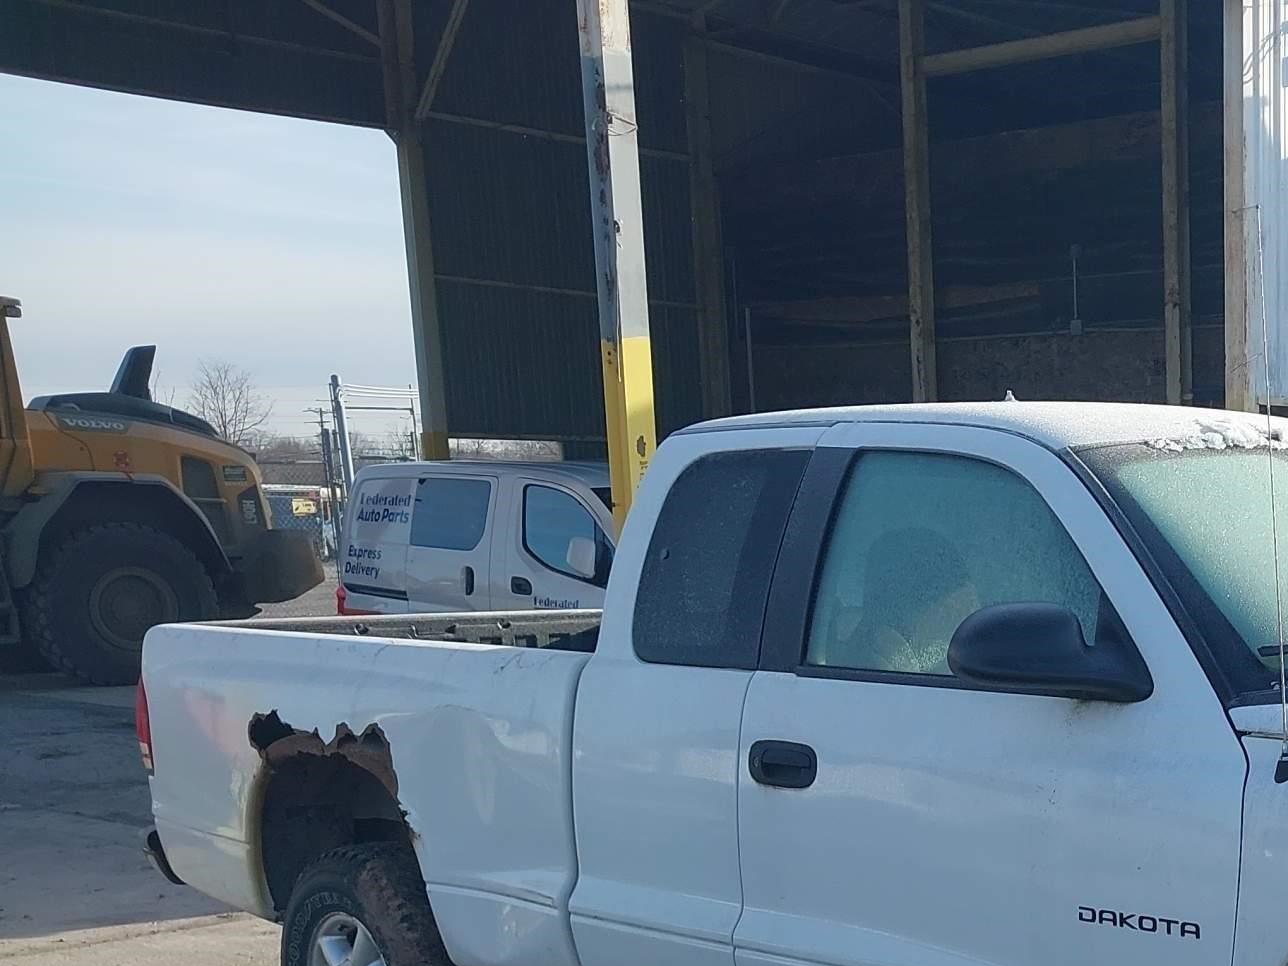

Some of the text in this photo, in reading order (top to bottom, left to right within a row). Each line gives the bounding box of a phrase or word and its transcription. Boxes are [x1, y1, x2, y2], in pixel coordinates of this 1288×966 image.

[61, 417, 125, 431] VOLVO
[355, 507, 410, 524] Auto Parts
[348, 544, 382, 561] Express
[344, 561, 381, 580] Delivery
[1078, 905, 1201, 940] DAKOTA
